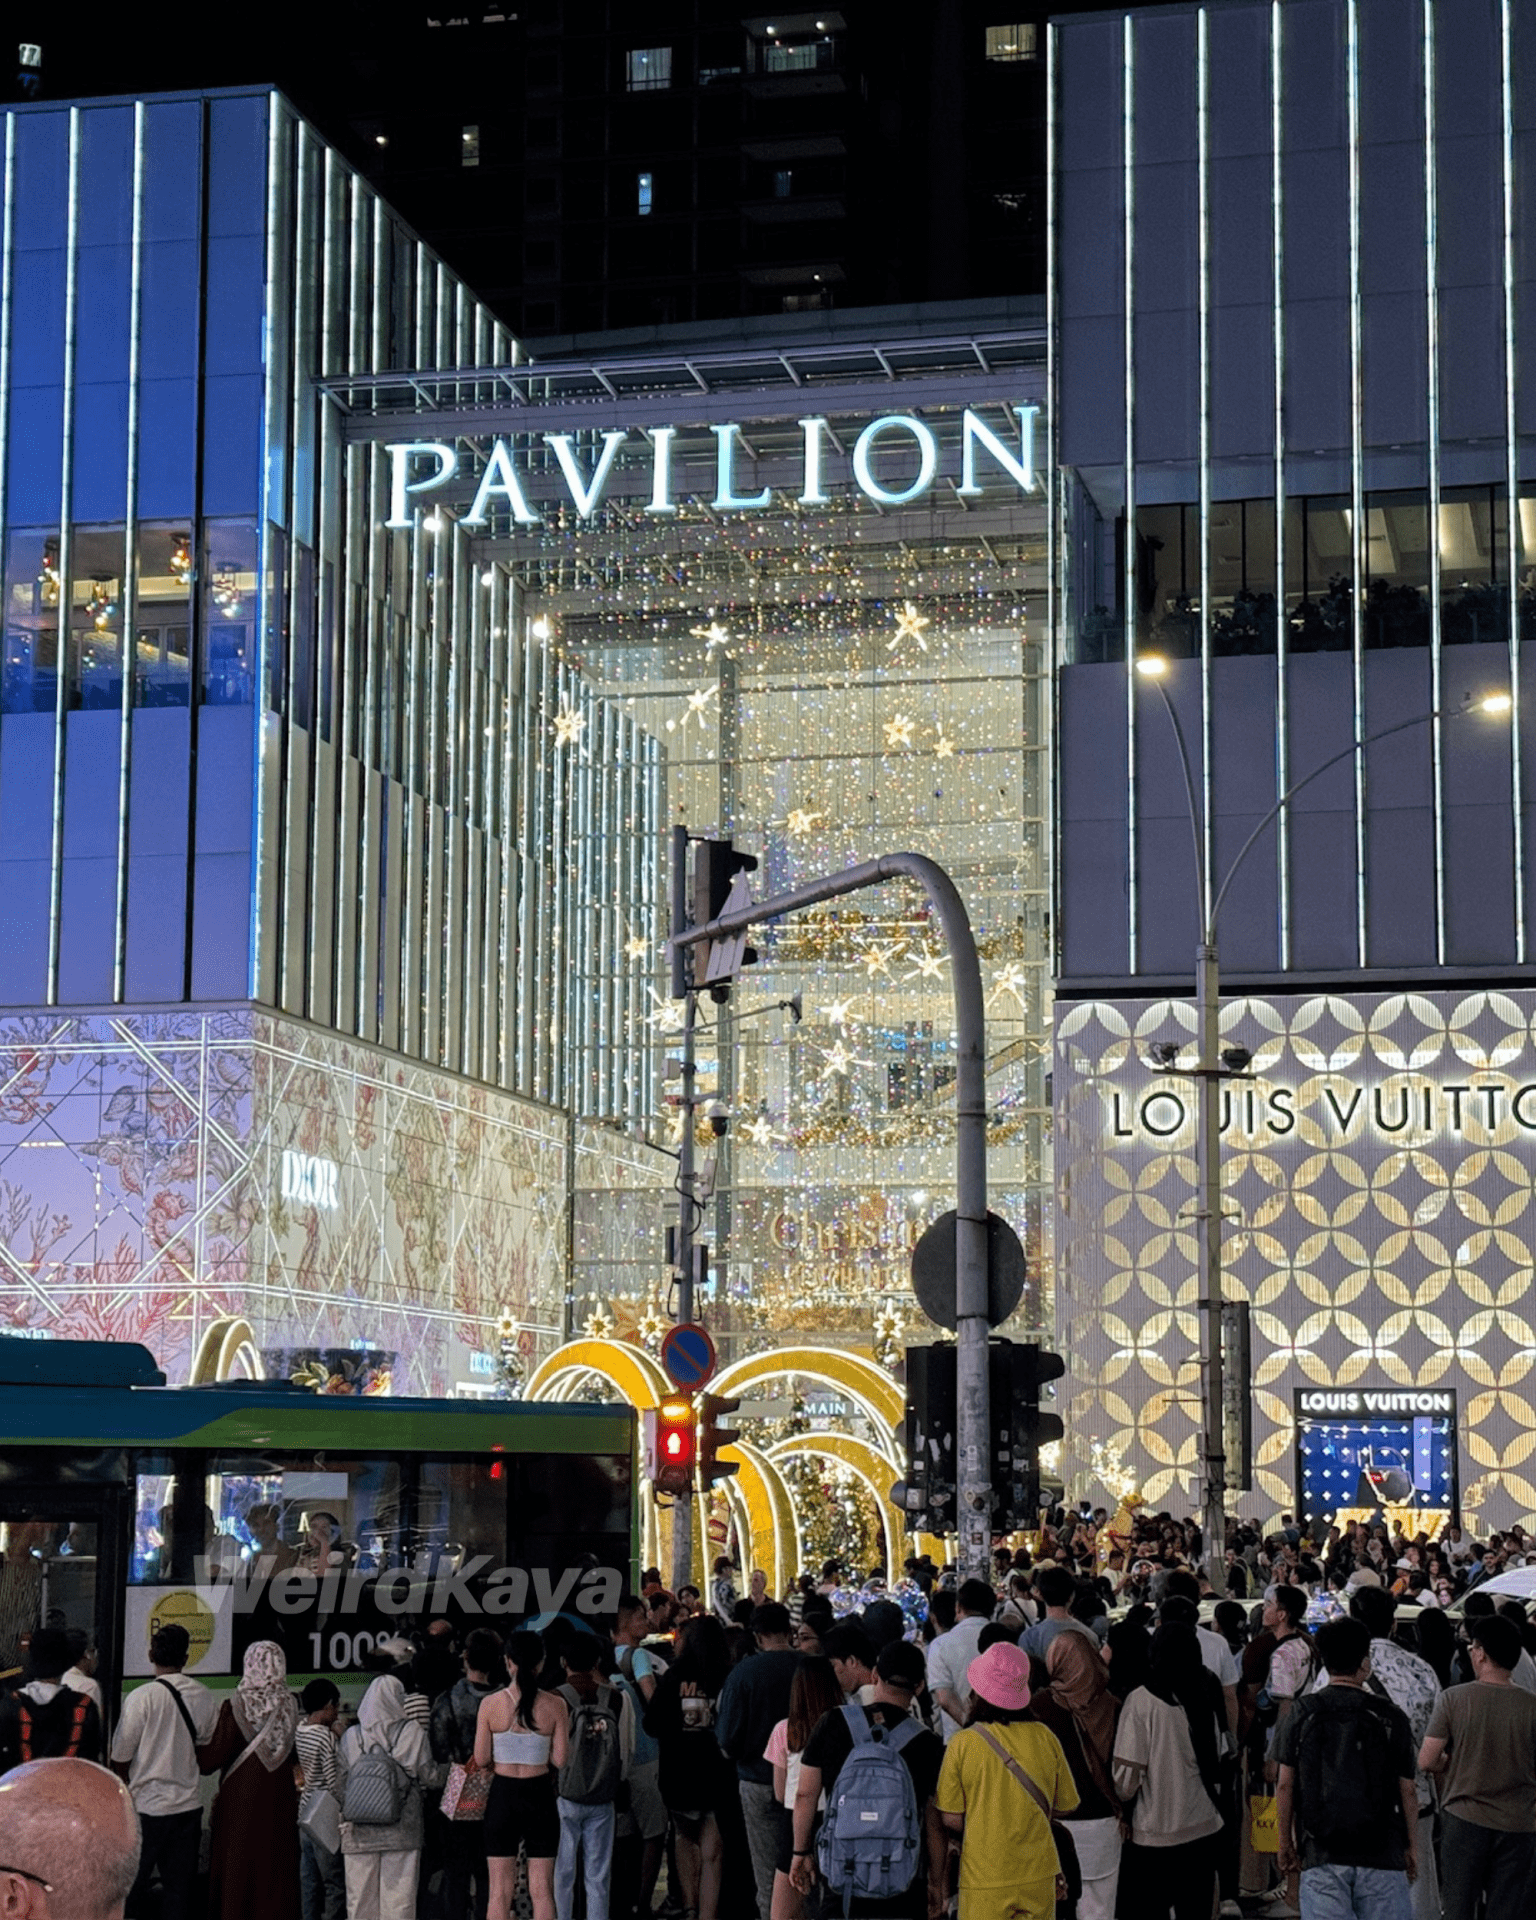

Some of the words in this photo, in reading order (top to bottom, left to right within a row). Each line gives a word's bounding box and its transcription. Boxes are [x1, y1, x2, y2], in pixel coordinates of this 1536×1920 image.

[384, 405, 1040, 529] PAVILION
[281, 1150, 339, 1210] DIOR
[770, 1210, 927, 1251] Christm
[803, 1402, 846, 1415] MAIN
[1300, 1393, 1360, 1411] LOUIS
[1363, 1393, 1450, 1411] VUITTON
